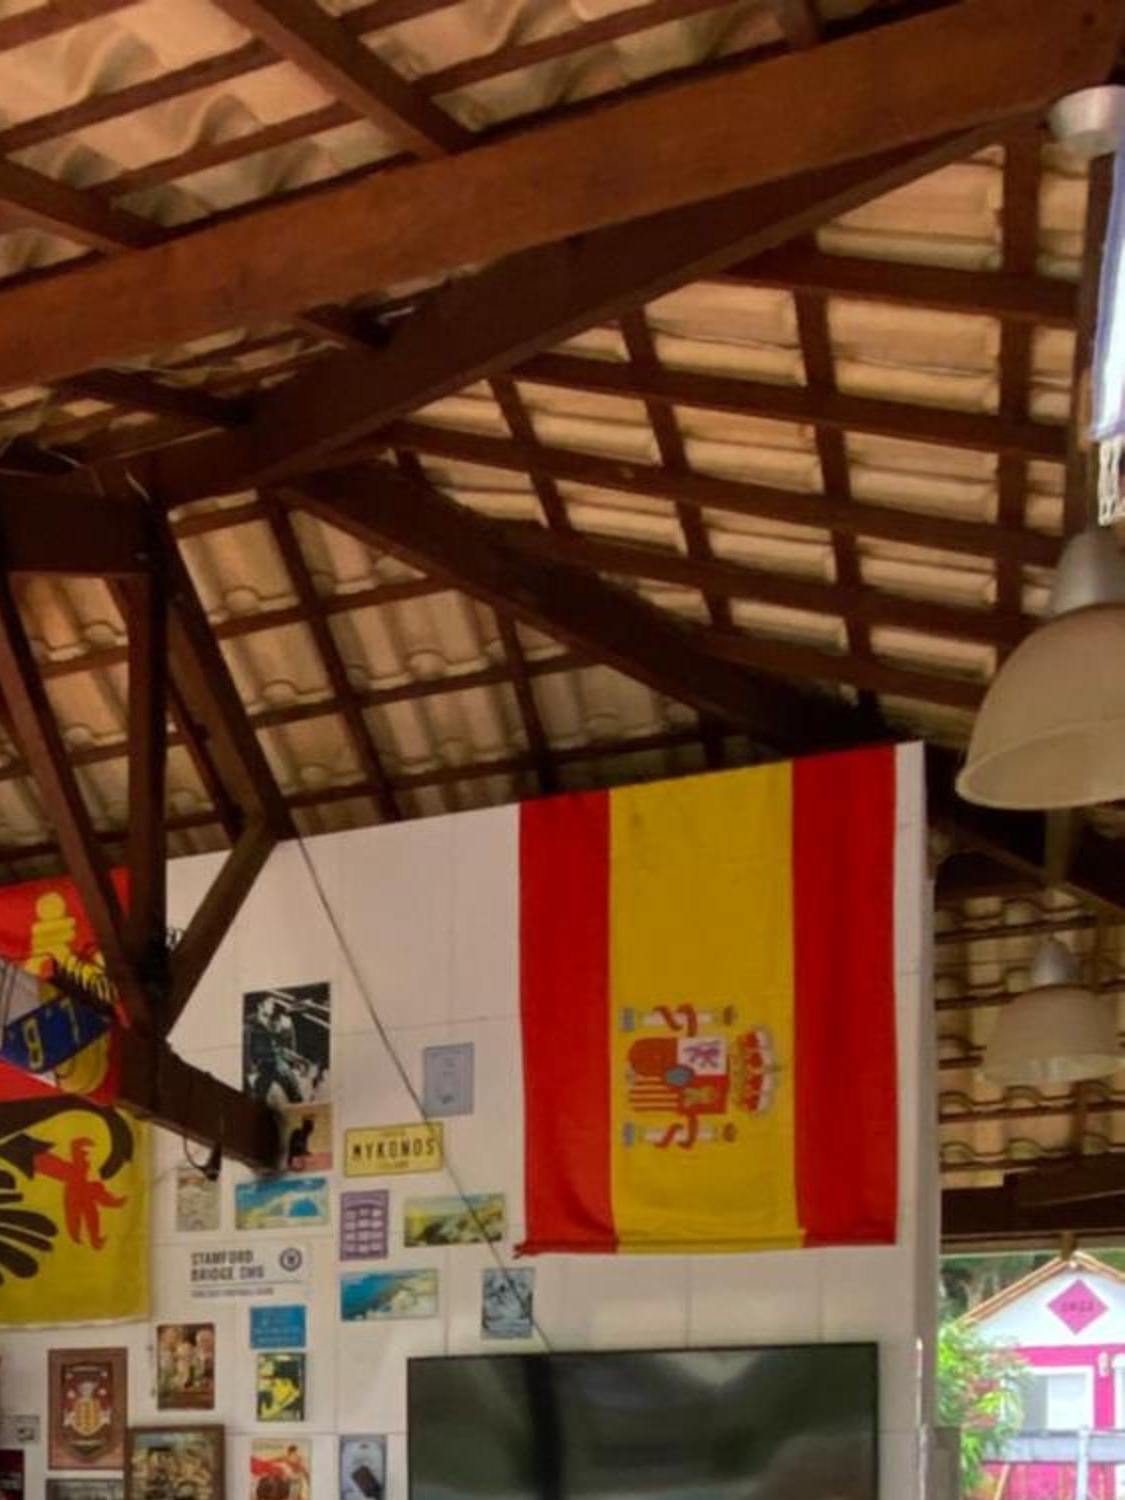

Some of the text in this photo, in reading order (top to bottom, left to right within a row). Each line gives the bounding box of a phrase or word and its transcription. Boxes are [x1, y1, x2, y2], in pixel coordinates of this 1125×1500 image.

[352, 1137, 436, 1161] MYKONOS
[191, 1250, 254, 1265] STAMFORD
[191, 1266, 234, 1281] BRIDGE
